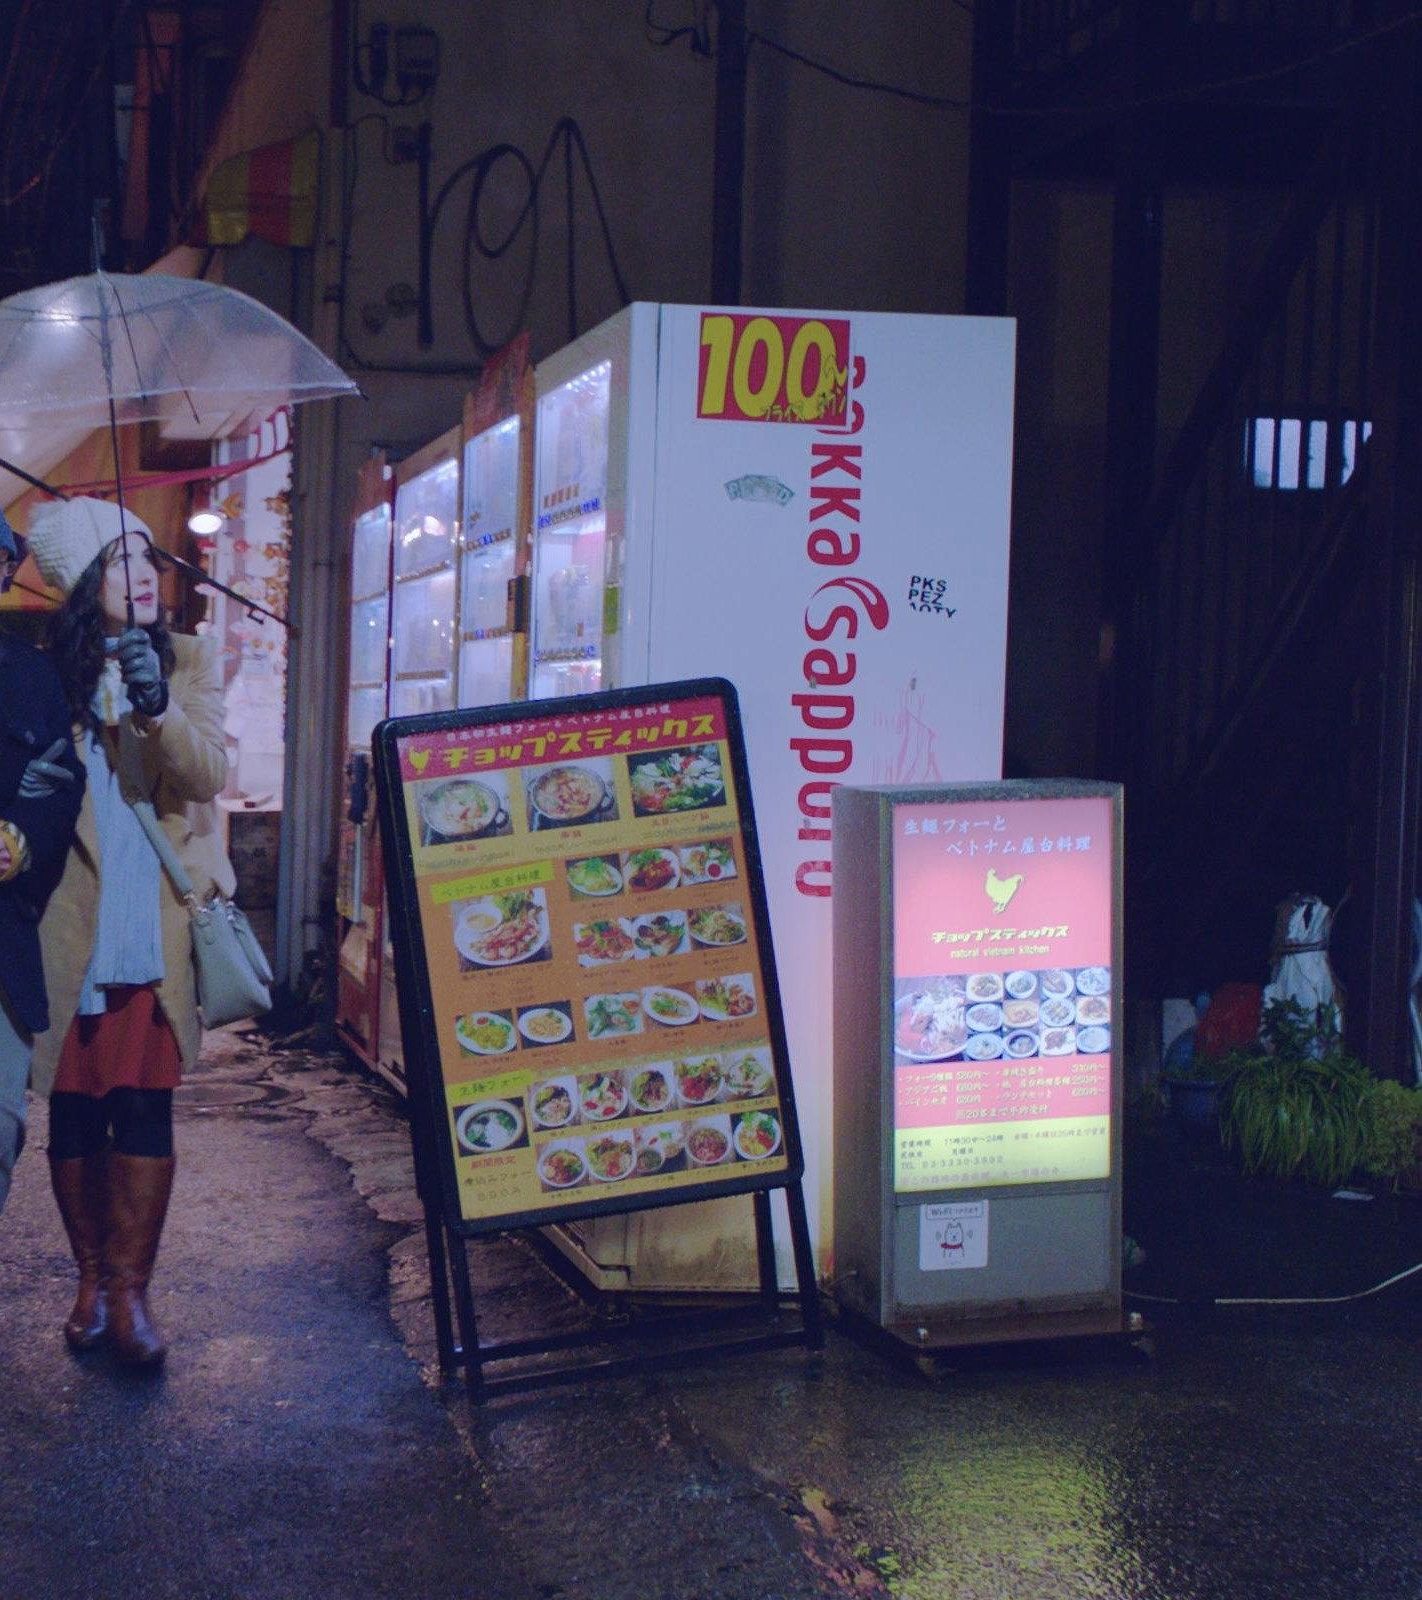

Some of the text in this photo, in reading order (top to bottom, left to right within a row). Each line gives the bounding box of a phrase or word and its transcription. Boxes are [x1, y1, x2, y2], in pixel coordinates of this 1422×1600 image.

[910, 575, 947, 592] PKS
[909, 588, 944, 606] PEZ
[442, 714, 716, 770] チョップスティックス
[946, 835, 1091, 857] ベトナム屋台料理
